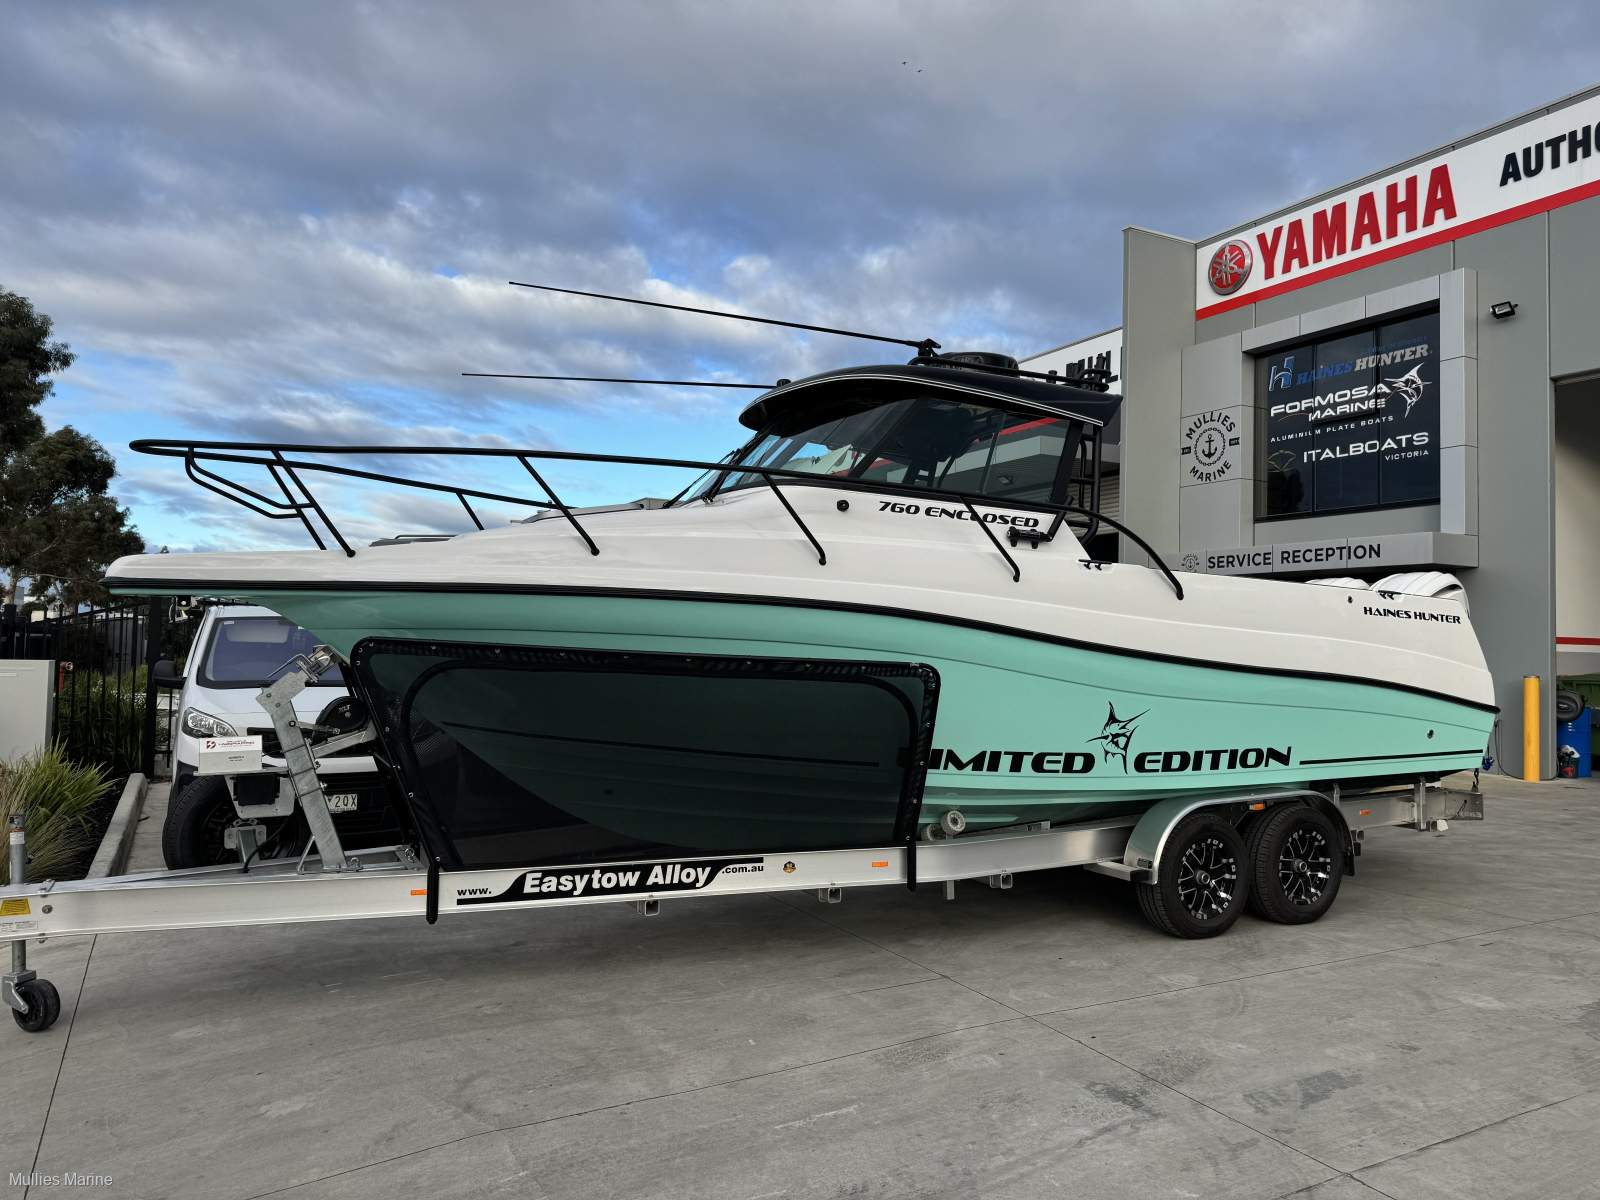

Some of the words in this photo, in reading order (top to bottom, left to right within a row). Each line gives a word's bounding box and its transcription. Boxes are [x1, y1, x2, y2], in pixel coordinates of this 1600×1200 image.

[1256, 163, 1458, 280] YAMAHA
[1296, 361, 1355, 385] HAINES
[1354, 343, 1429, 372] HUNTER
[1270, 382, 1391, 417] FORMOSA
[1308, 398, 1386, 422] MARINE
[1185, 411, 1236, 440] MULLIES
[1326, 423, 1355, 433] PLATE
[1360, 415, 1394, 427] BOATS
[1303, 431, 1429, 463] ITALBOATS
[1384, 449, 1429, 461] VICTORIA
[1189, 460, 1231, 482] MARINE
[878, 501, 920, 515] 760
[1207, 552, 1272, 569] SERVICE
[1280, 543, 1381, 564] RECEPTION
[1363, 606, 1412, 619] HAINES
[1414, 611, 1461, 624] HUNTER
[926, 748, 1096, 774] IMITED
[1133, 746, 1293, 773] EDITION
[456, 888, 492, 896] www.
[523, 869, 640, 896] Easytow
[646, 864, 712, 888] Alloy
[721, 864, 764, 874] .com.au
